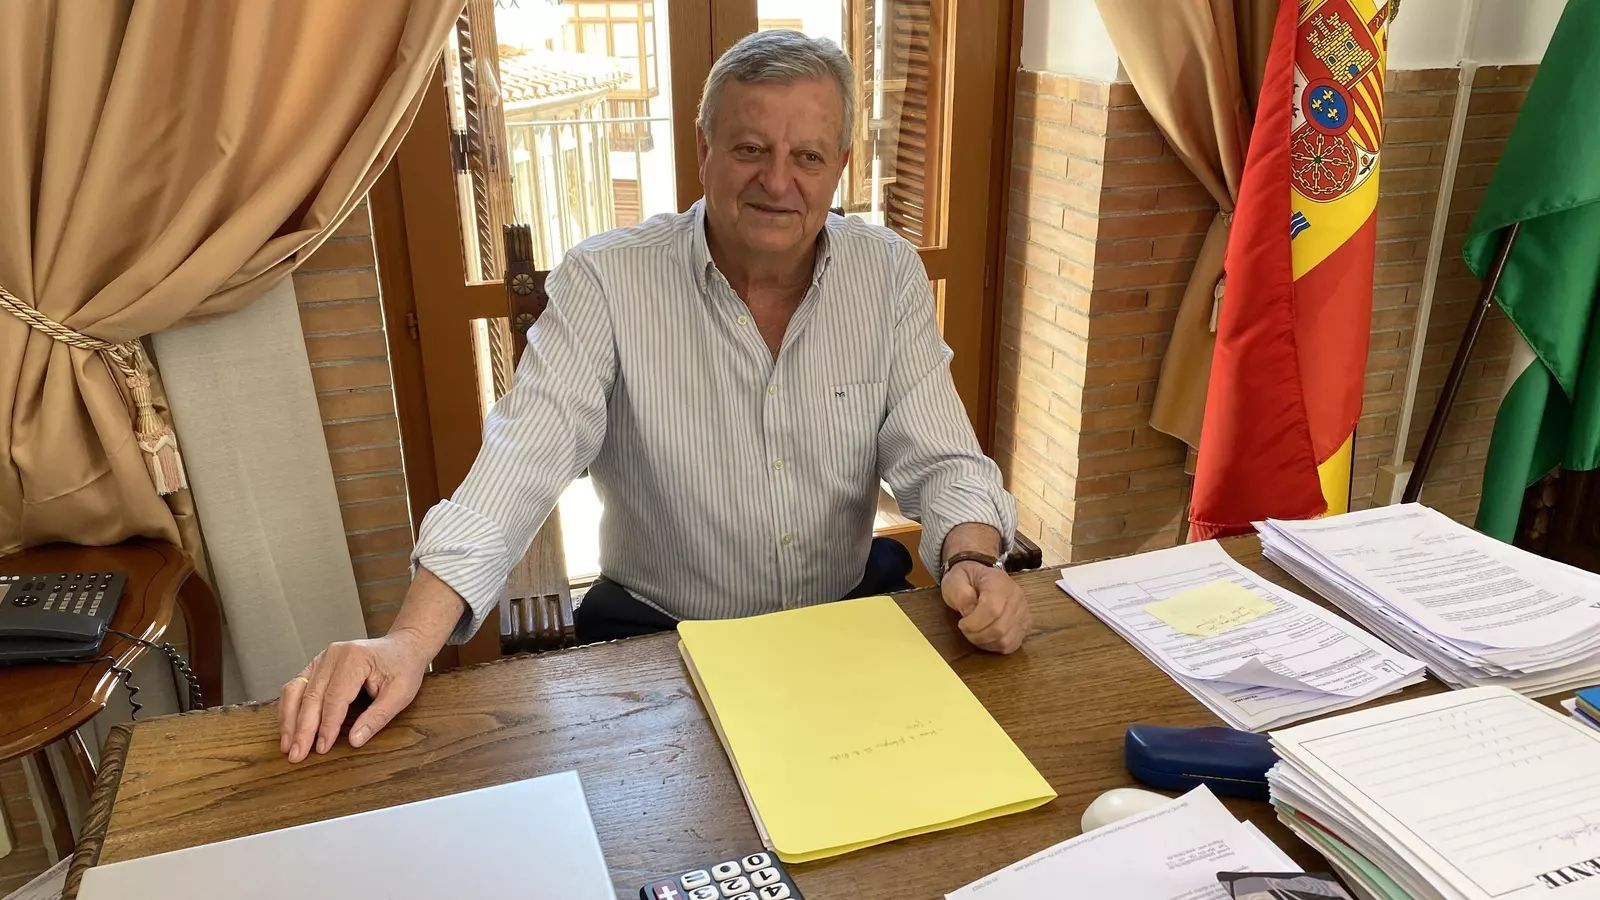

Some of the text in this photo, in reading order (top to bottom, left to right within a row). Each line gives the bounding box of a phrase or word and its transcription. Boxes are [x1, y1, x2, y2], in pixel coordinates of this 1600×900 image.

[747, 854, 764, 866] 0
[758, 871, 772, 881] 1
[724, 879, 742, 890] 2
[764, 886, 782, 897] 4
